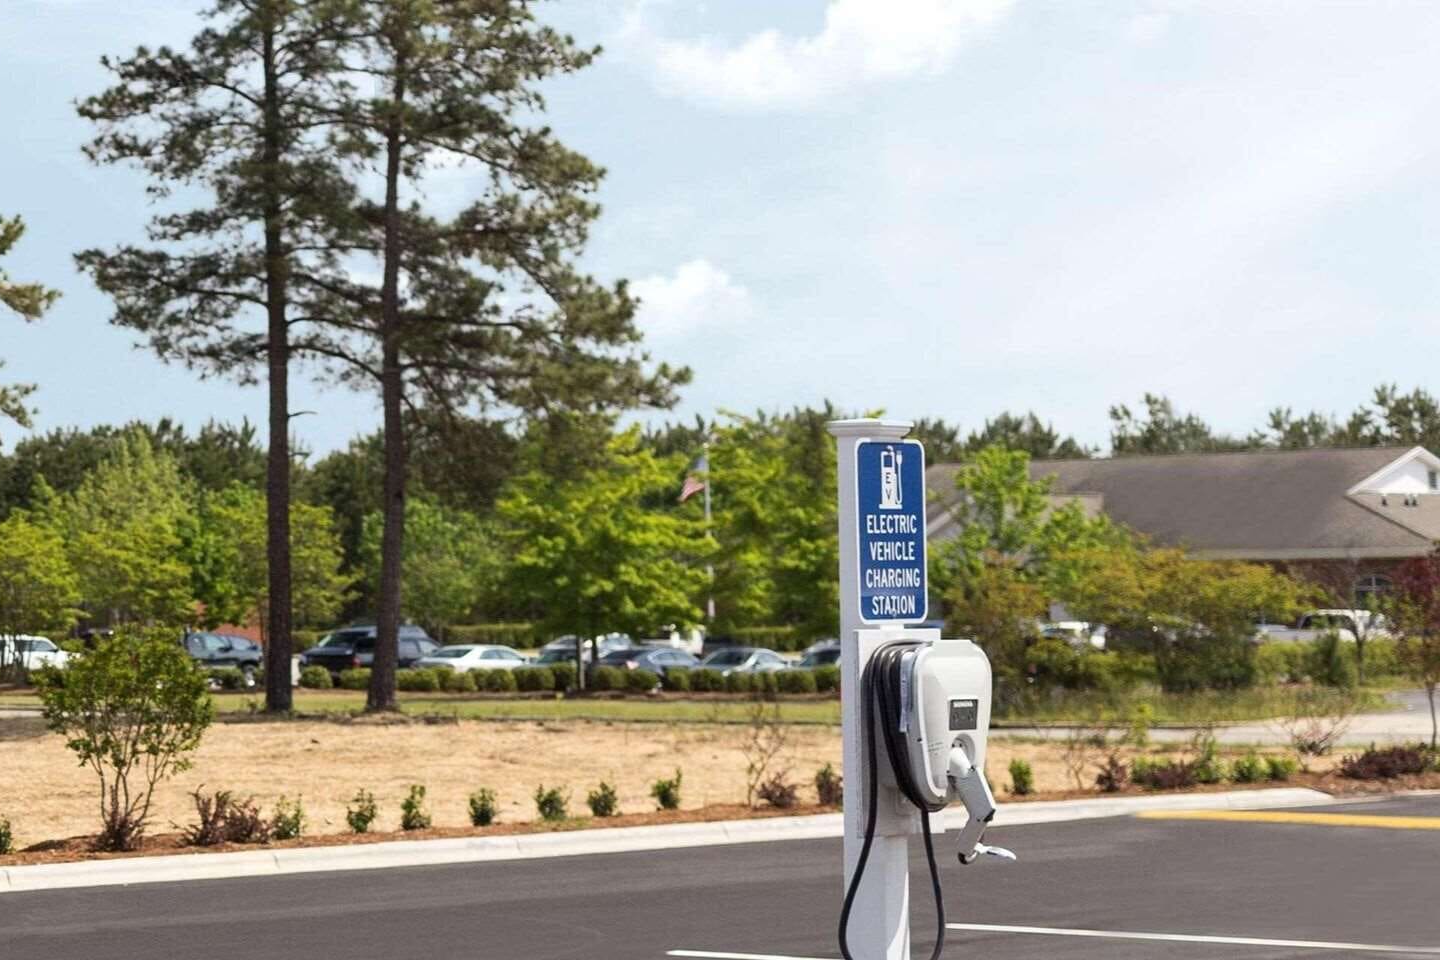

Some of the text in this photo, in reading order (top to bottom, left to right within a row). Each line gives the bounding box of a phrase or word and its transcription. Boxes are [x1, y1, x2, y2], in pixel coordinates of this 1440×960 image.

[866, 514, 918, 534] ELECTRIC
[869, 541, 915, 561] VEHICLE
[866, 568, 921, 588] CHARGING
[871, 595, 916, 616] STATION
